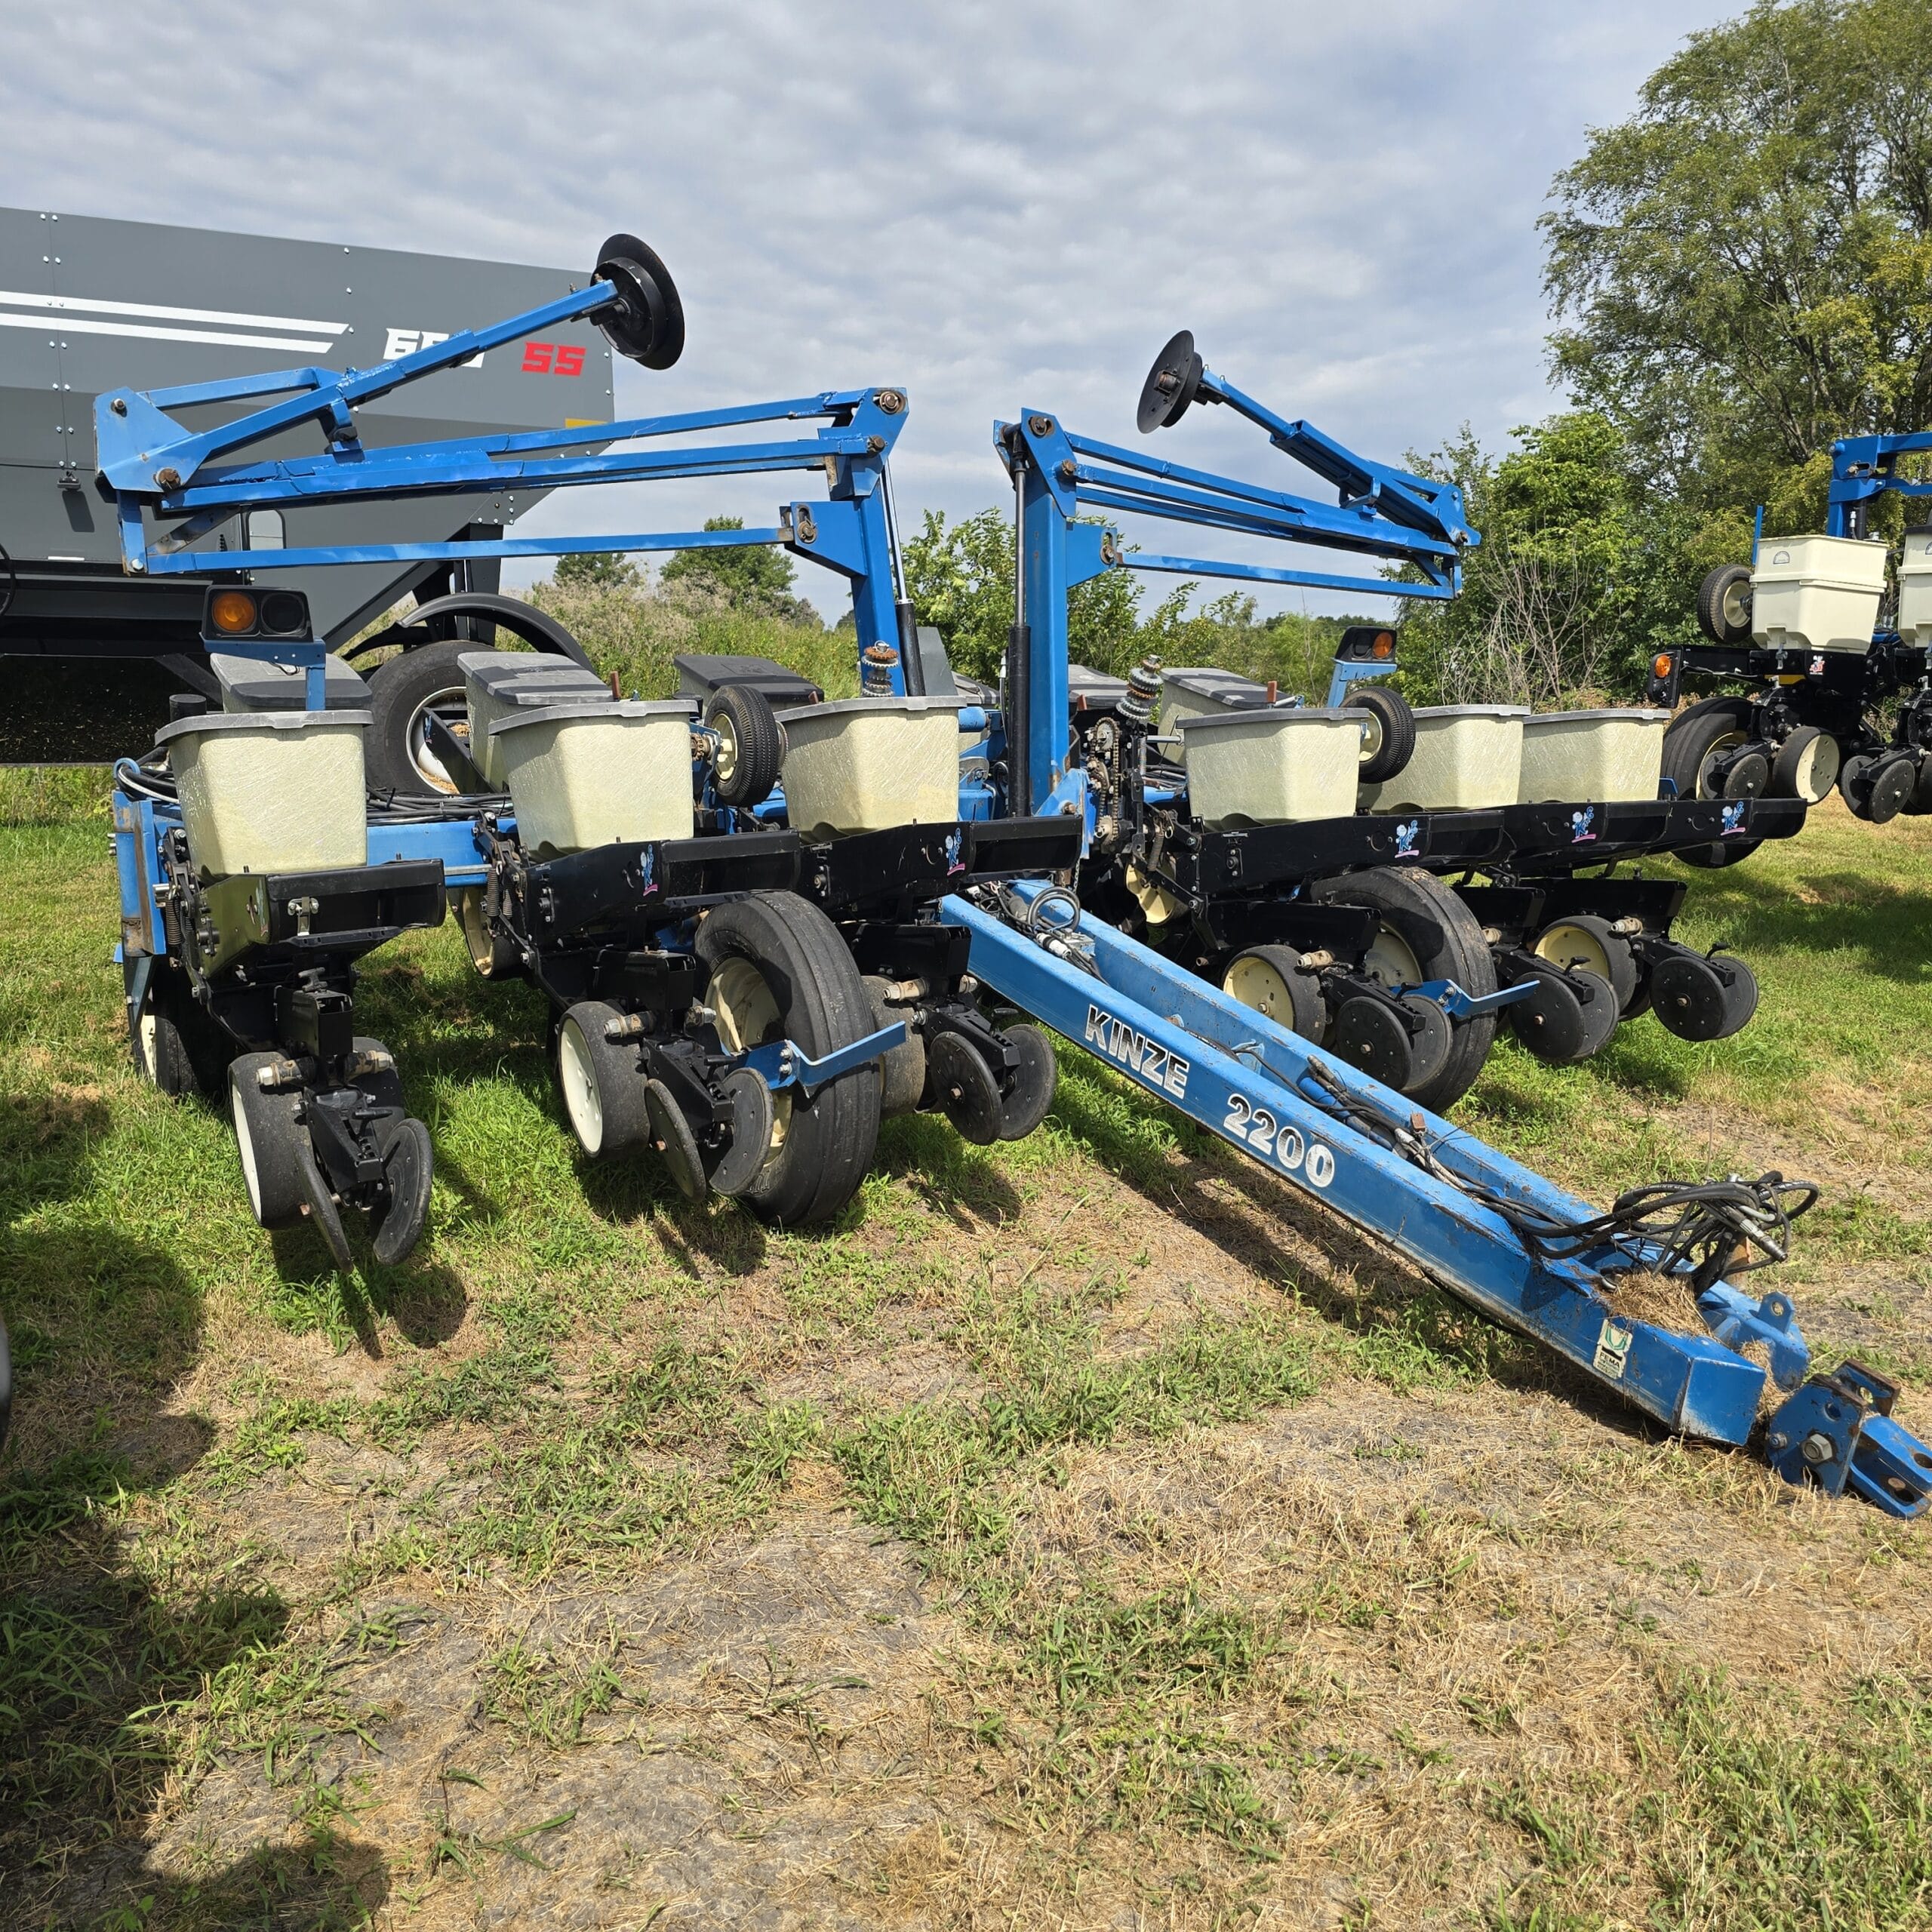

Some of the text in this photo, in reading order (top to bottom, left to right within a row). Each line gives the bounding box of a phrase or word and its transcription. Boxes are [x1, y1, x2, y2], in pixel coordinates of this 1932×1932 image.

[1084, 1004, 1190, 1099] KINZE
[1223, 1093, 1335, 1188] 2200
[1600, 1352, 1620, 1368] FEMA
